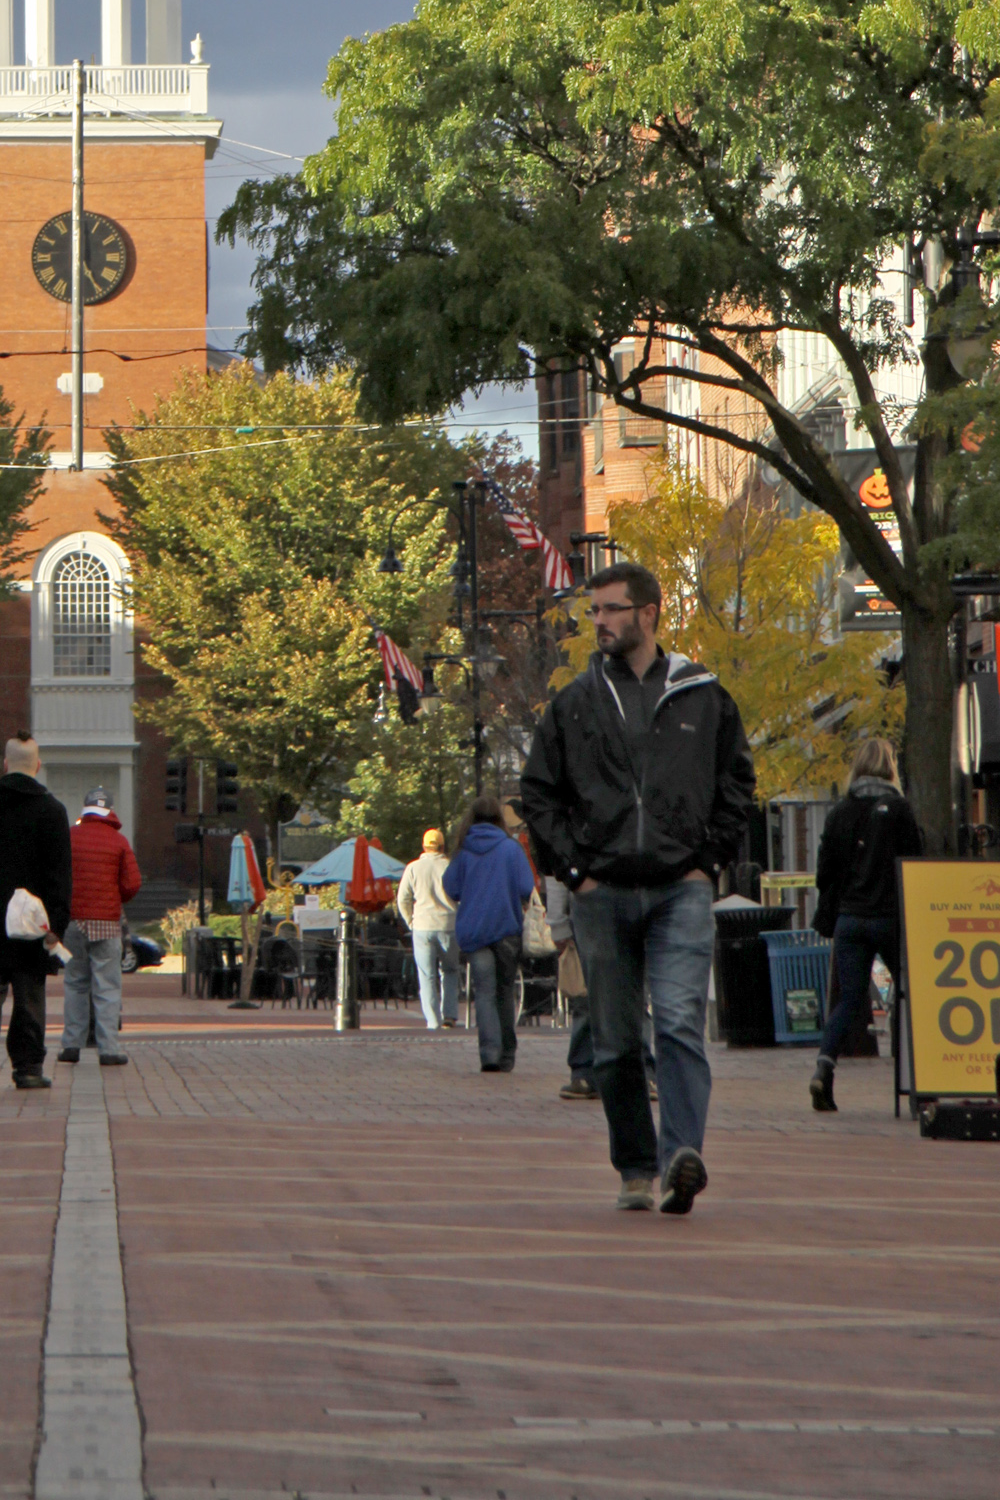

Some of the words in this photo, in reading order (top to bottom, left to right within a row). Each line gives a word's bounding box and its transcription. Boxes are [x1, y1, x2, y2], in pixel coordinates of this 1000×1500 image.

[930, 902, 950, 911] BUY
[953, 902, 973, 911] ANY
[979, 902, 1000, 911] PAIR
[942, 1053, 964, 1062] ANY
[965, 1065, 982, 1075] OR
